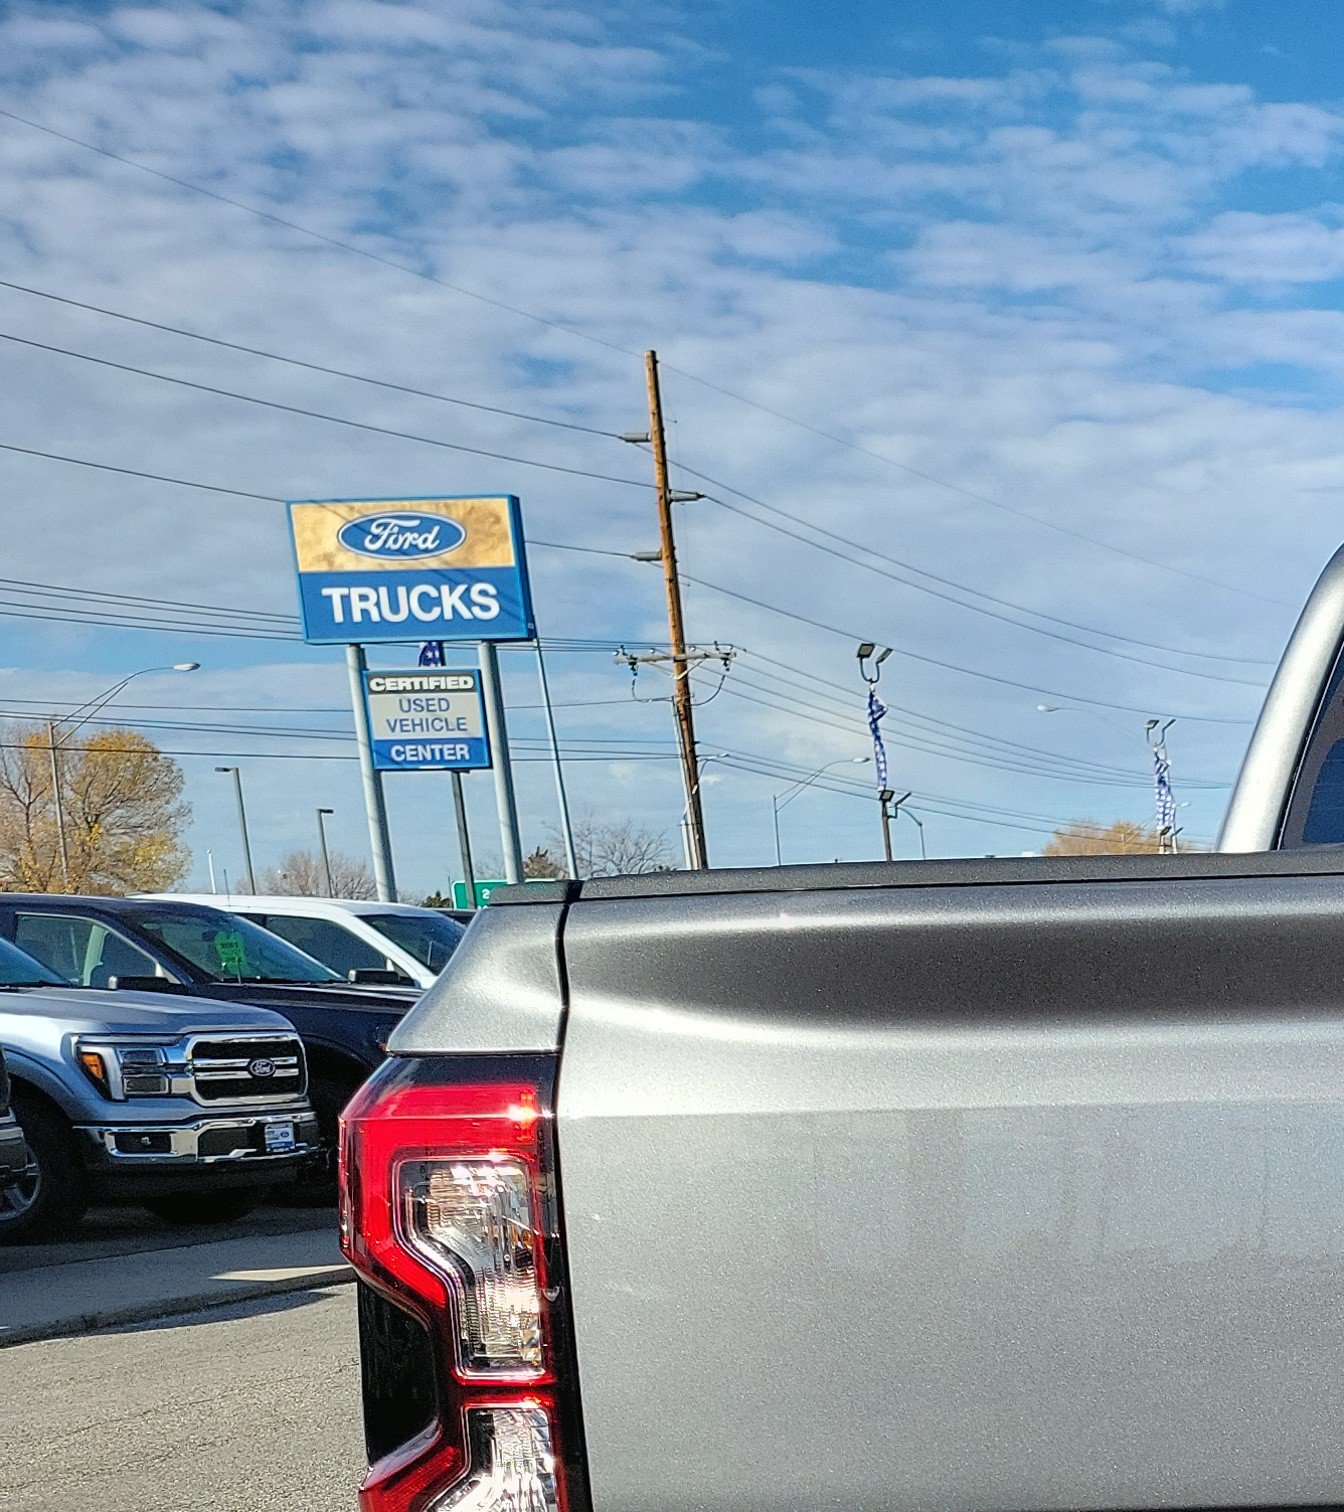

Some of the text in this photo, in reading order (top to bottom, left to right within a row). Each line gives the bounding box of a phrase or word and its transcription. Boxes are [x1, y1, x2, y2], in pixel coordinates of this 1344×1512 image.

[363, 519, 440, 553] Ford
[322, 582, 500, 623] TRUCKS
[369, 675, 475, 692] CERTIFIED
[399, 697, 450, 714] USED
[386, 716, 468, 734] VEHICLE
[390, 743, 470, 762] CENTER
